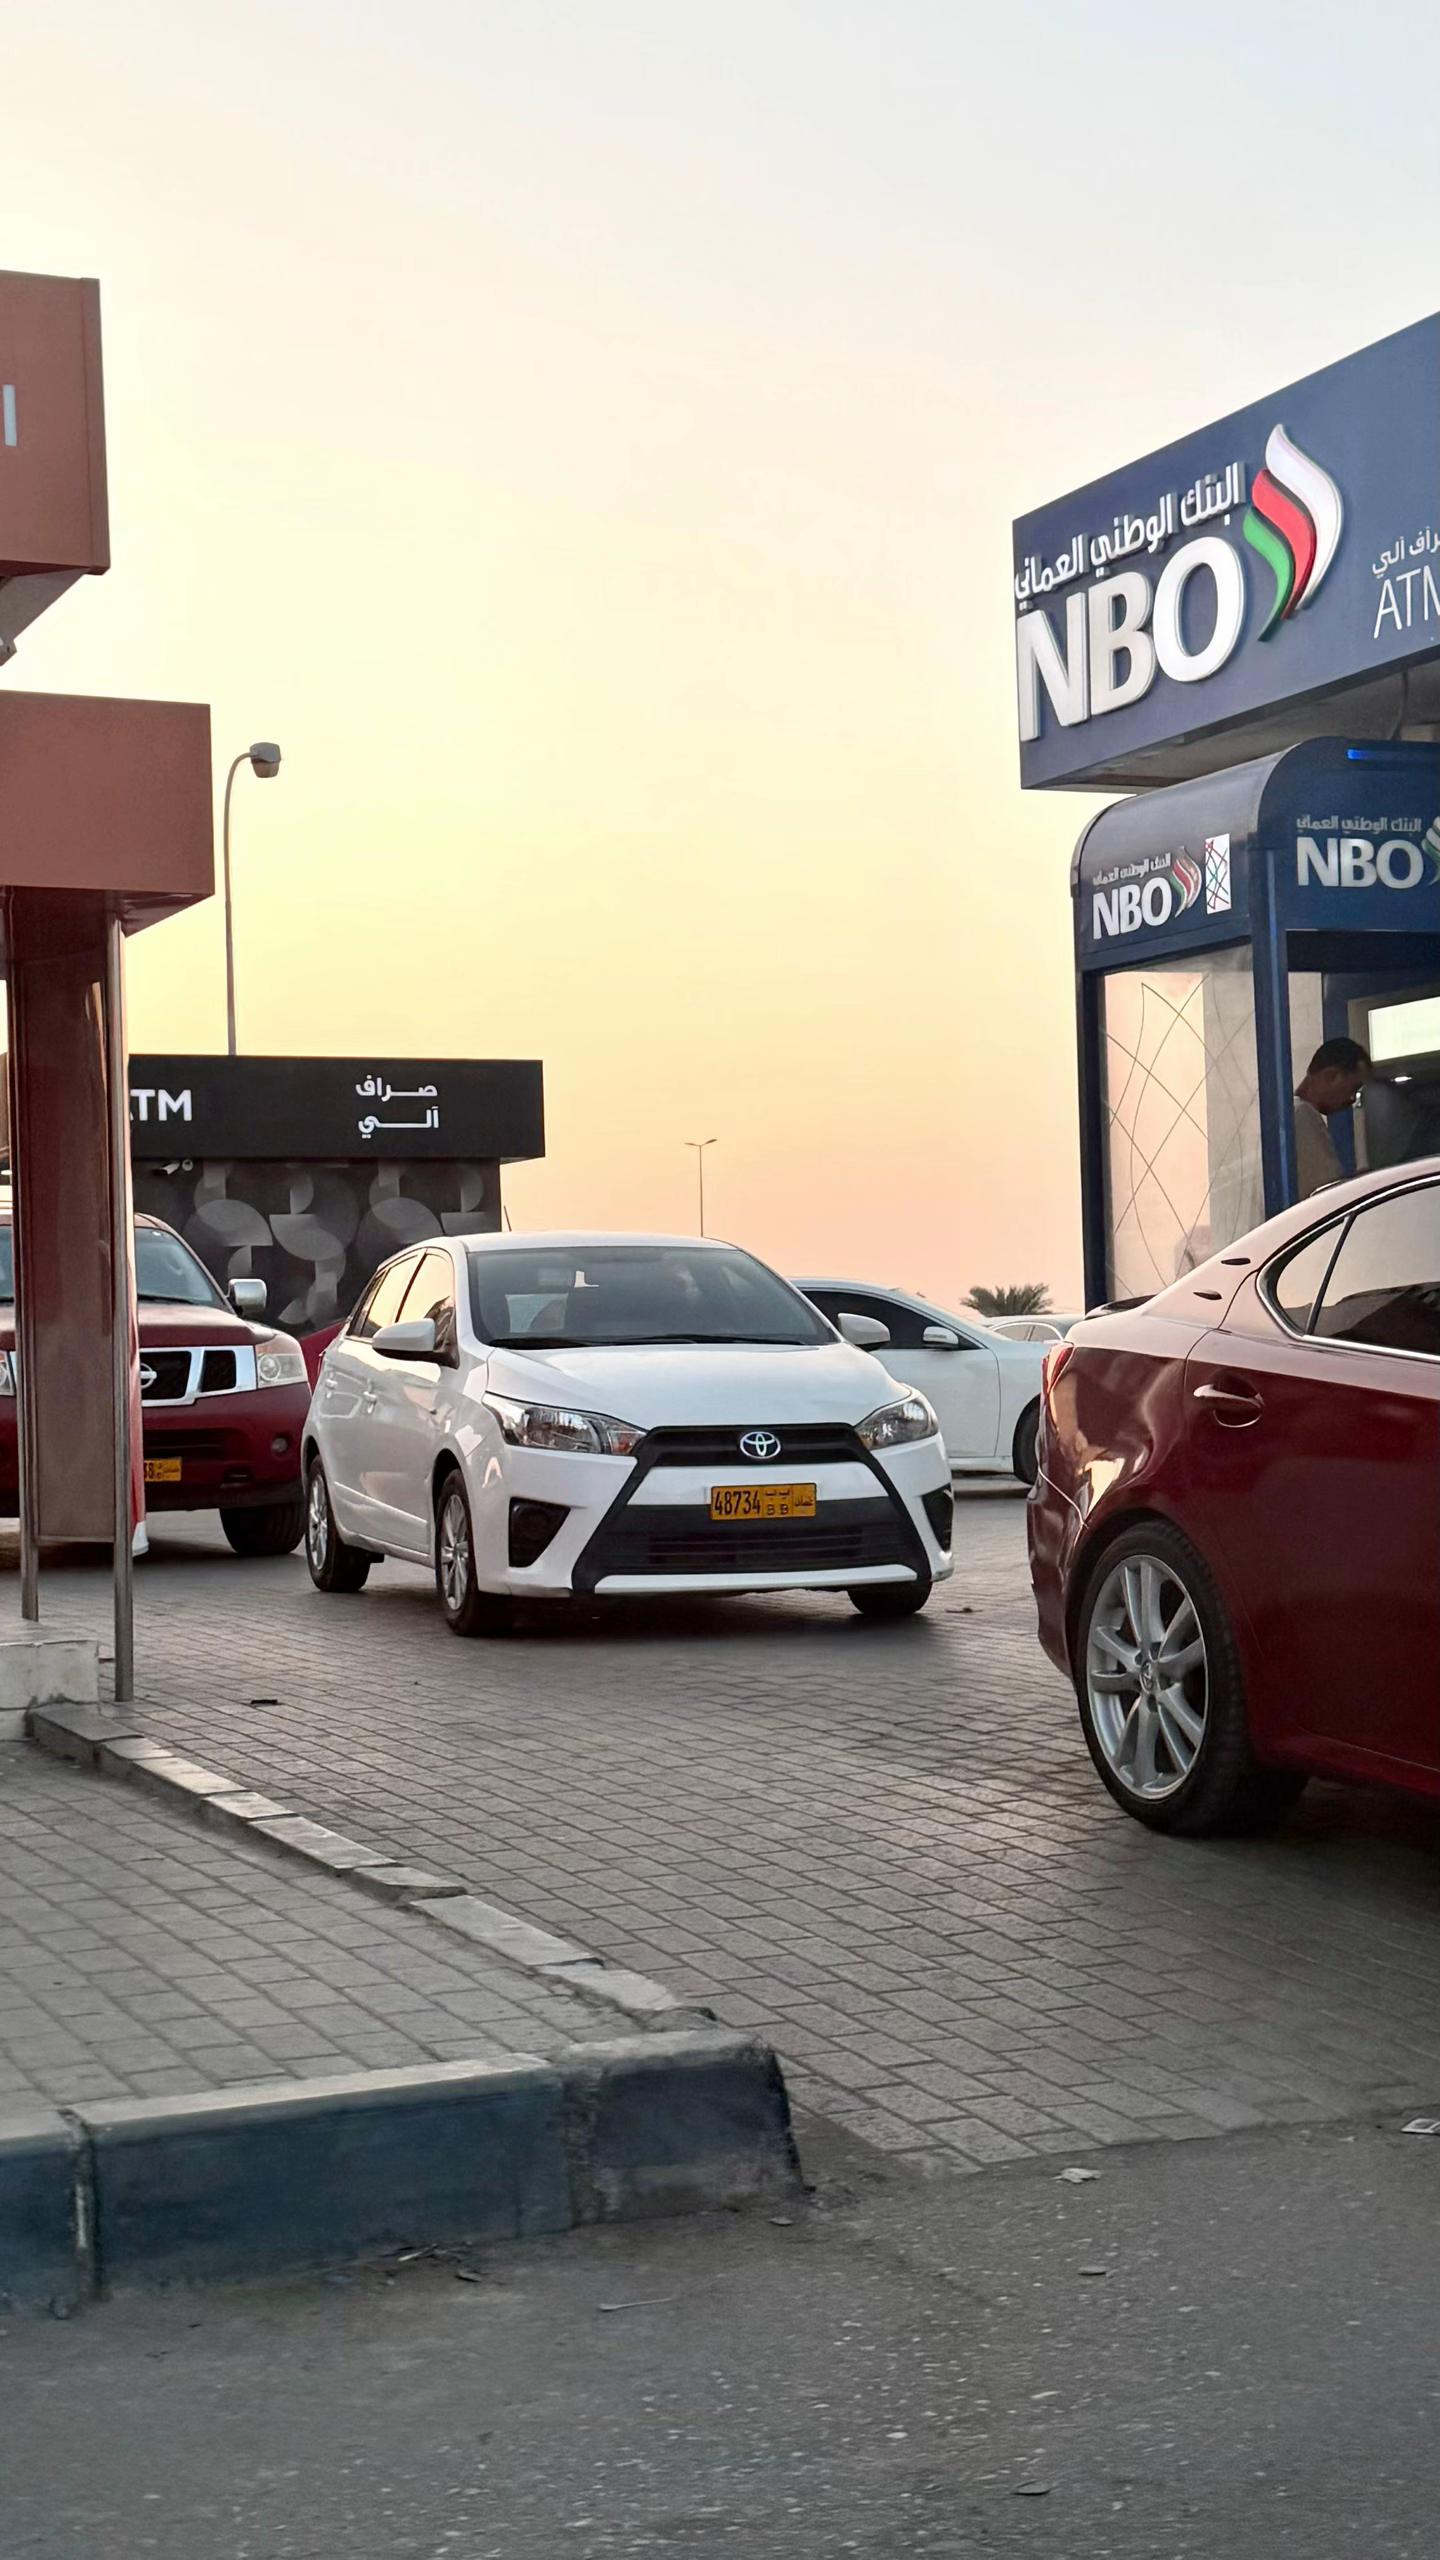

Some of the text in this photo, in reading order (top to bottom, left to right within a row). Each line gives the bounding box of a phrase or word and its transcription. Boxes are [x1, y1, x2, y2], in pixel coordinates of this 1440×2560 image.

[1014, 462, 1241, 611] البنك الوطني العماني
[1409, 526, 1440, 556] راف
[1016, 536, 1245, 742] NBO
[1296, 836, 1424, 889] NBO
[1093, 877, 1172, 940] NBO
[130, 1089, 192, 1121] TM
[355, 1074, 438, 1102] صراف
[358, 1105, 439, 1139] آلي
[715, 1490, 760, 1516] 48734
